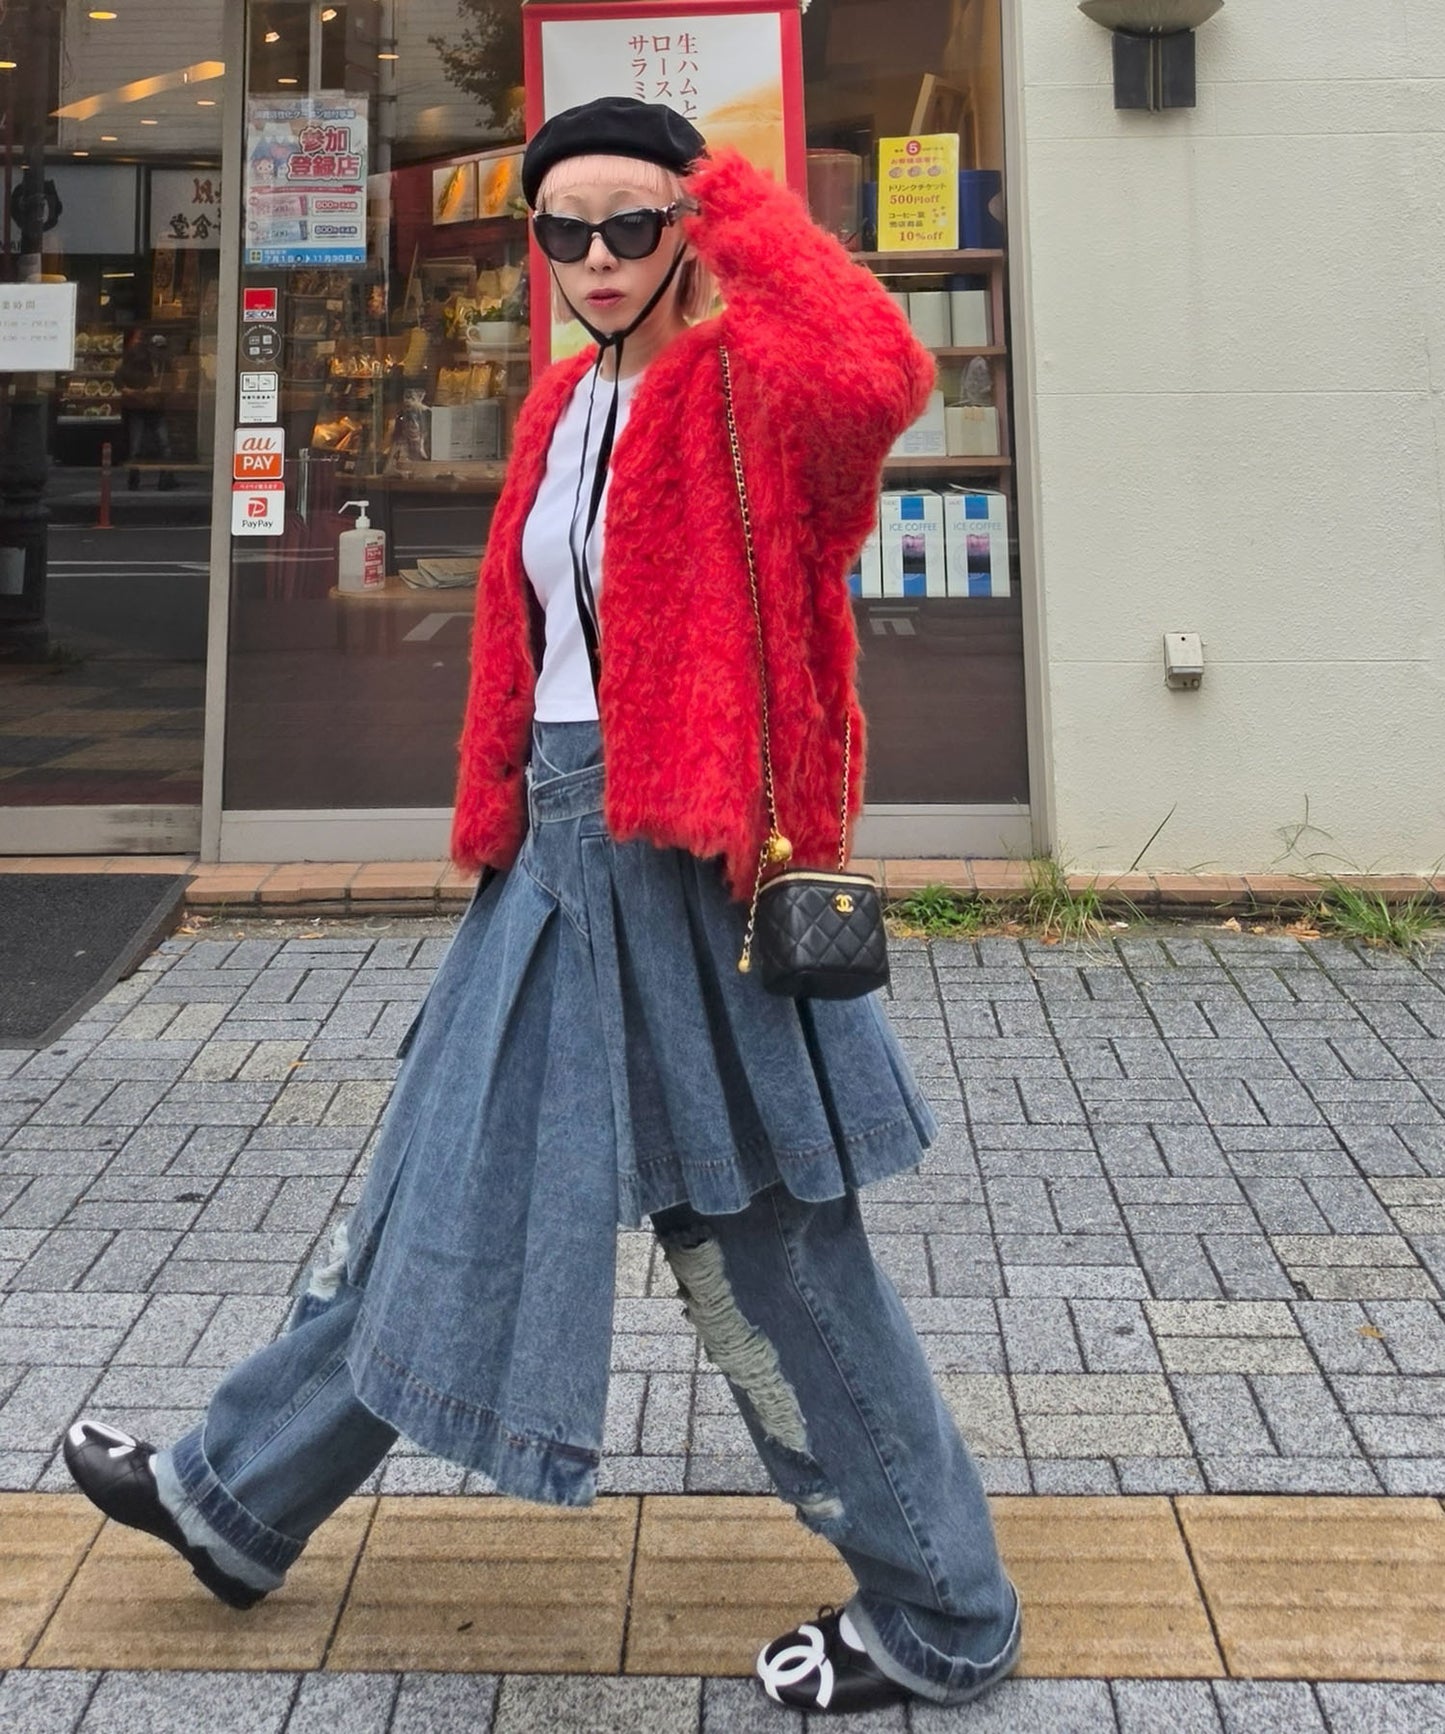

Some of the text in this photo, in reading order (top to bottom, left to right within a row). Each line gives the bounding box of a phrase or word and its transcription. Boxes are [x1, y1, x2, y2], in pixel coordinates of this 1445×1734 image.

[628, 35, 649, 99] サラミ
[651, 35, 673, 98] ロース
[677, 33, 699, 120] 生ハムと
[300, 128, 348, 153] 参加
[288, 154, 361, 179] 登録店
[888, 183, 946, 193] ドリンクチケット
[889, 194, 941, 205] 500円off
[242, 437, 276, 451] au
[243, 456, 275, 471] PAY
[241, 519, 273, 529] PayPay
[889, 523, 937, 531] ICE COFFEE
[954, 522, 1002, 531] ICE COFFEE
